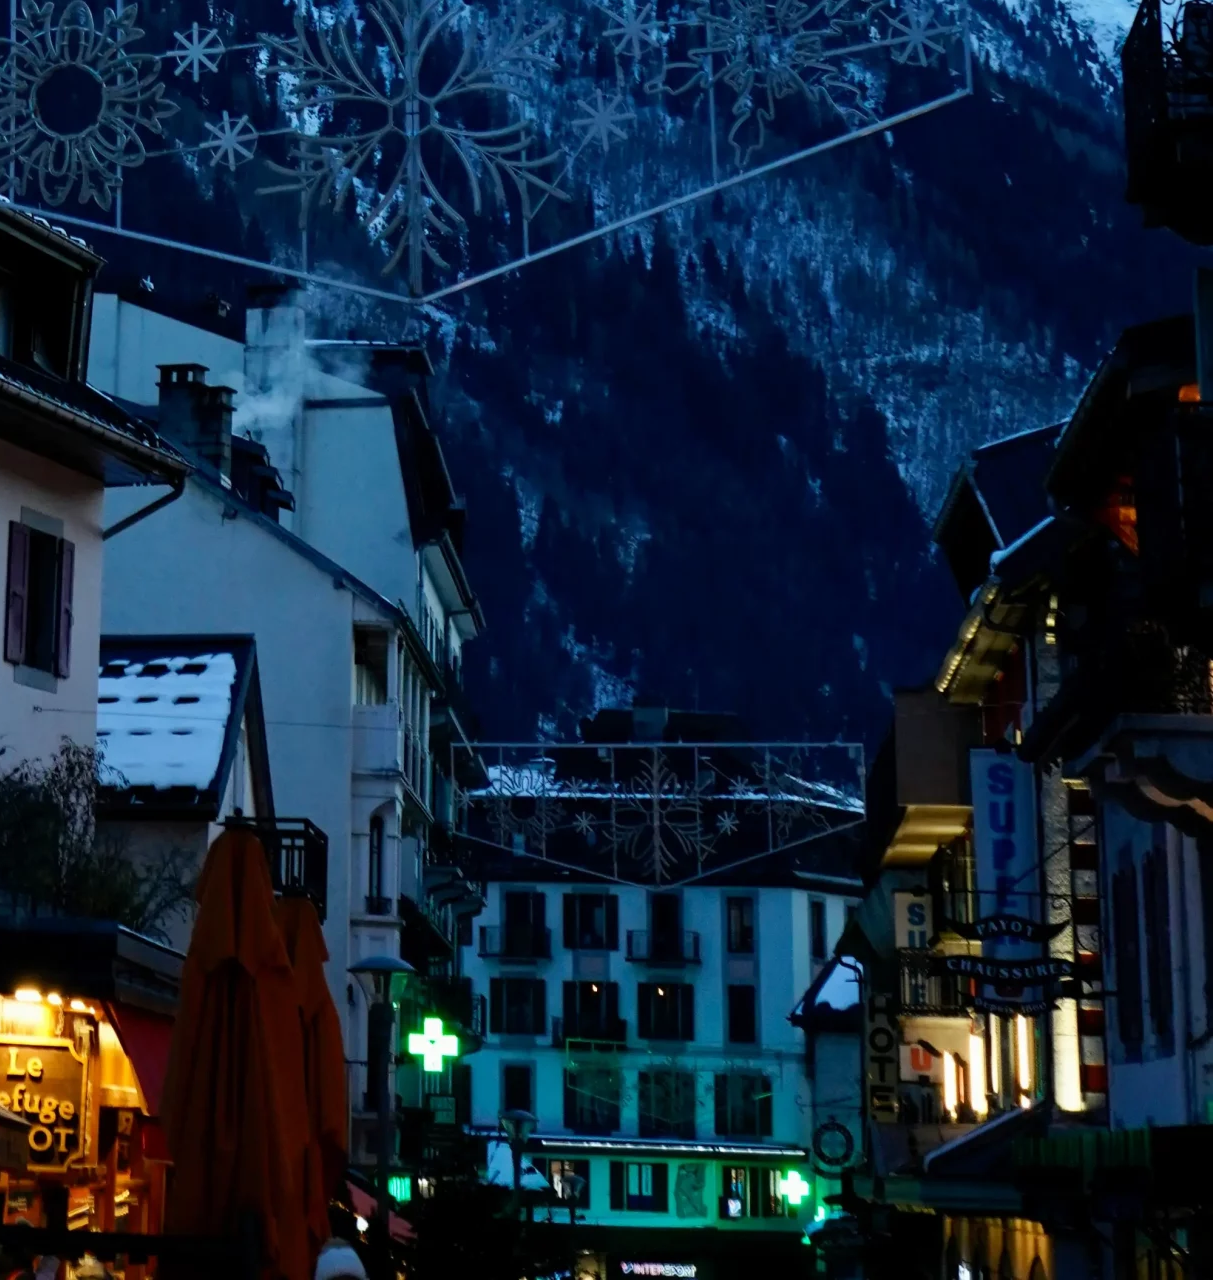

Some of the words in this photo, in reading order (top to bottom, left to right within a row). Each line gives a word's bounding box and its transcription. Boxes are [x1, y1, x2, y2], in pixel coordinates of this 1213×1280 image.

[975, 919, 1034, 937] PAYOT
[946, 958, 1073, 979] CHAUSSURES
[6, 1047, 43, 1077] Le
[869, 996, 895, 1120] HOTE
[633, 1263, 697, 1278] INTERSPORT
